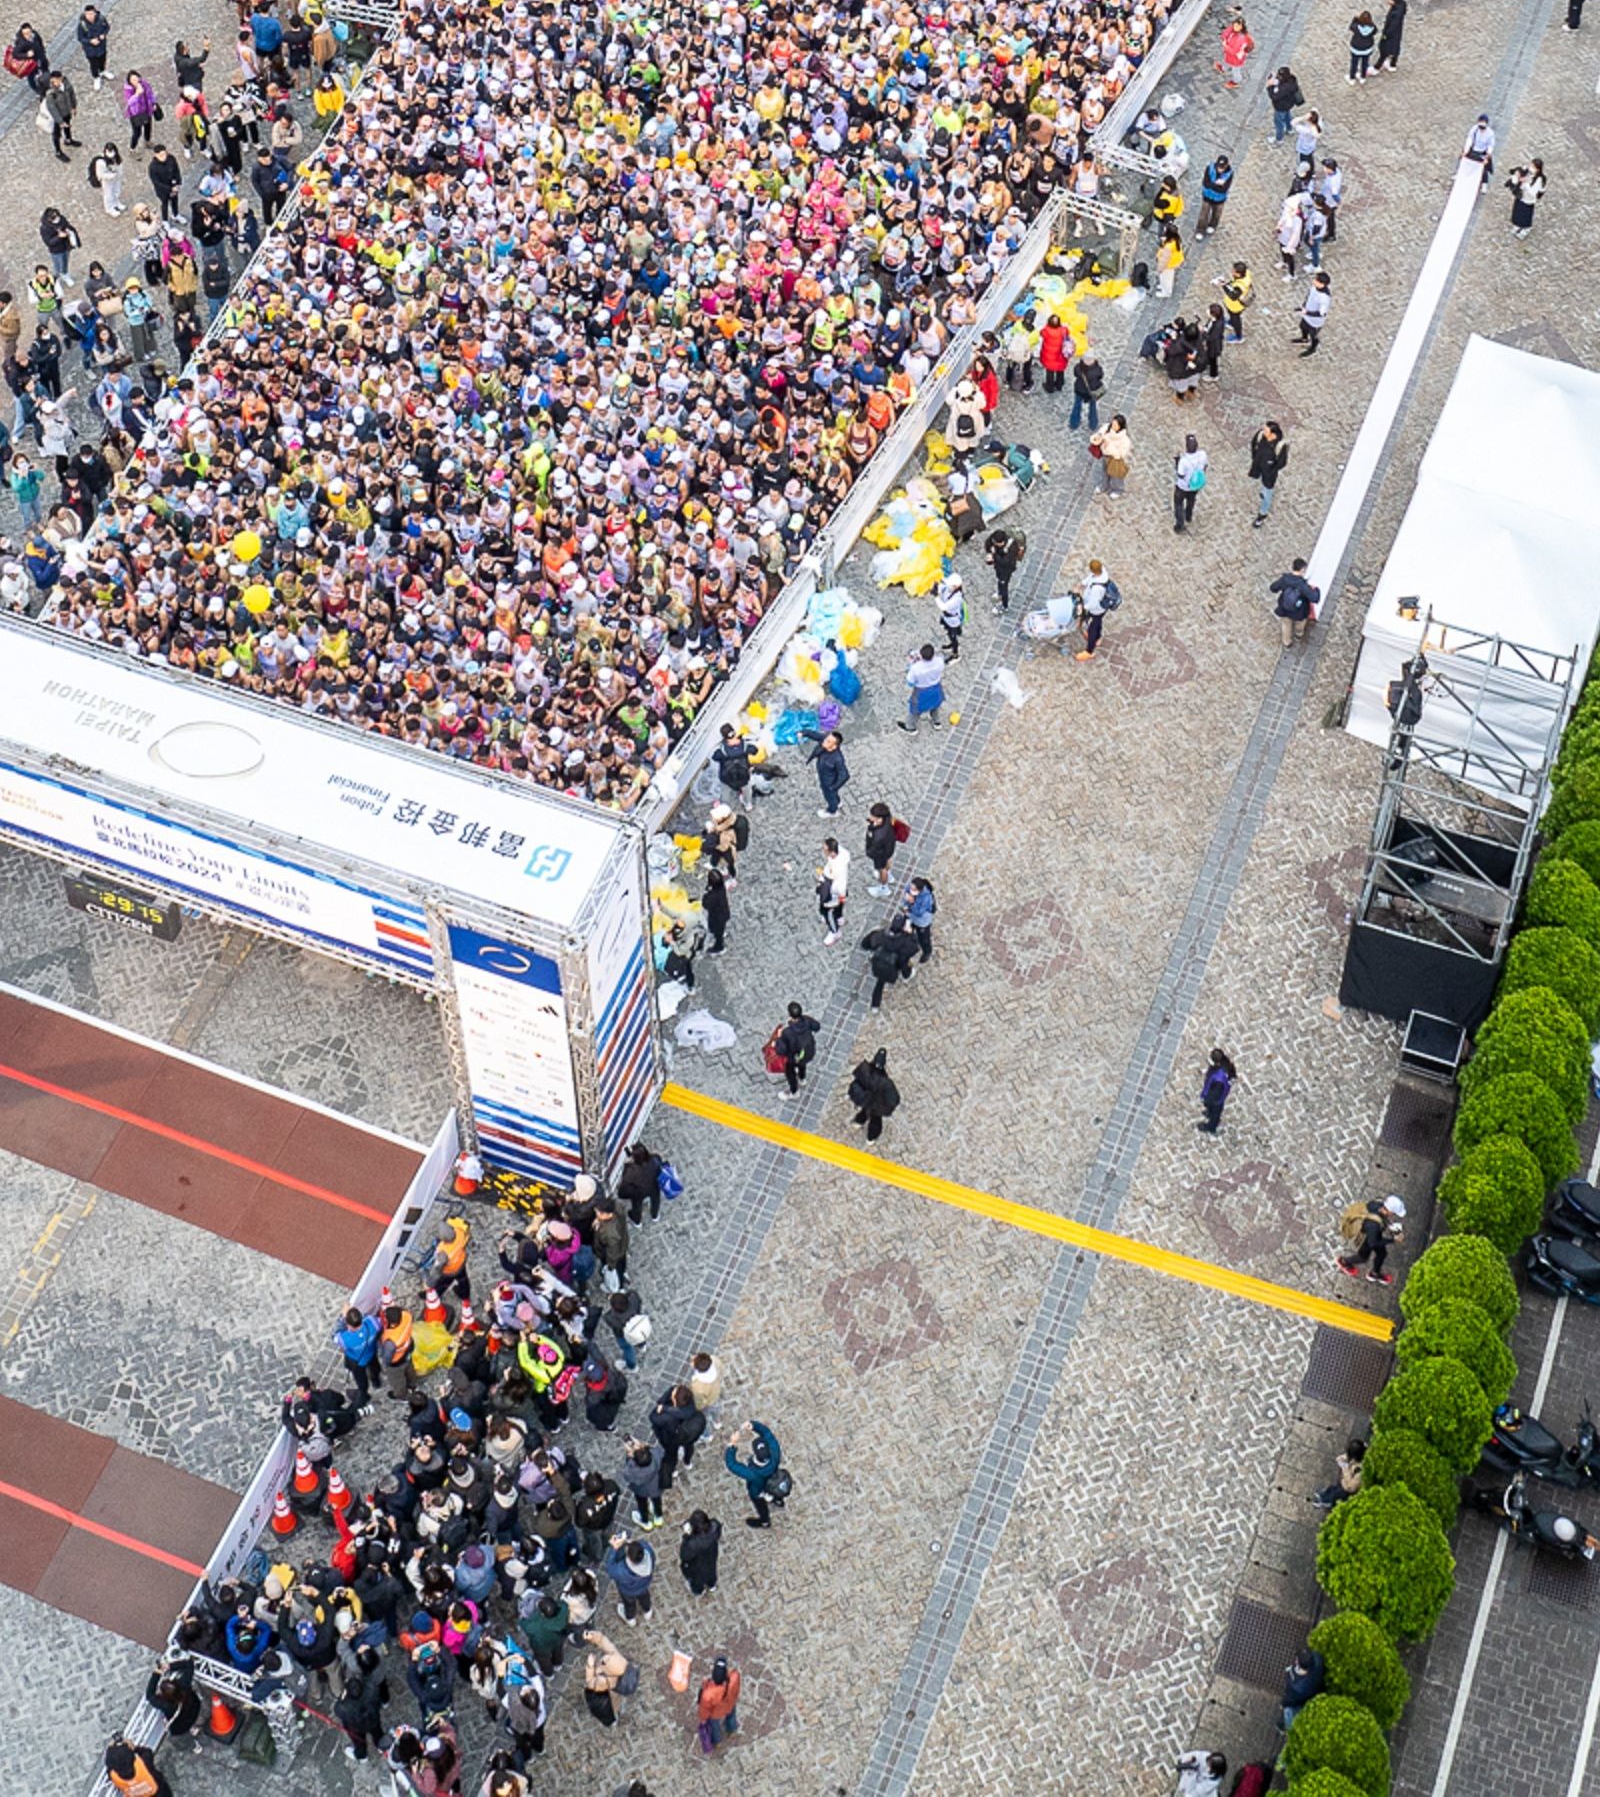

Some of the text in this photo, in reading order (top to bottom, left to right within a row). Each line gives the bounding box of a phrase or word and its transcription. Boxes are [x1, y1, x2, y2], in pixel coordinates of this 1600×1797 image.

[43, 680, 157, 727] MARATHON
[74, 710, 142, 744] TAIPEI
[328, 775, 391, 804] Financial
[341, 794, 383, 816] Fubon
[393, 799, 527, 860] 富邦金控
[93, 815, 310, 901] Redefine Your Limits
[85, 903, 153, 935] CITIZEN
